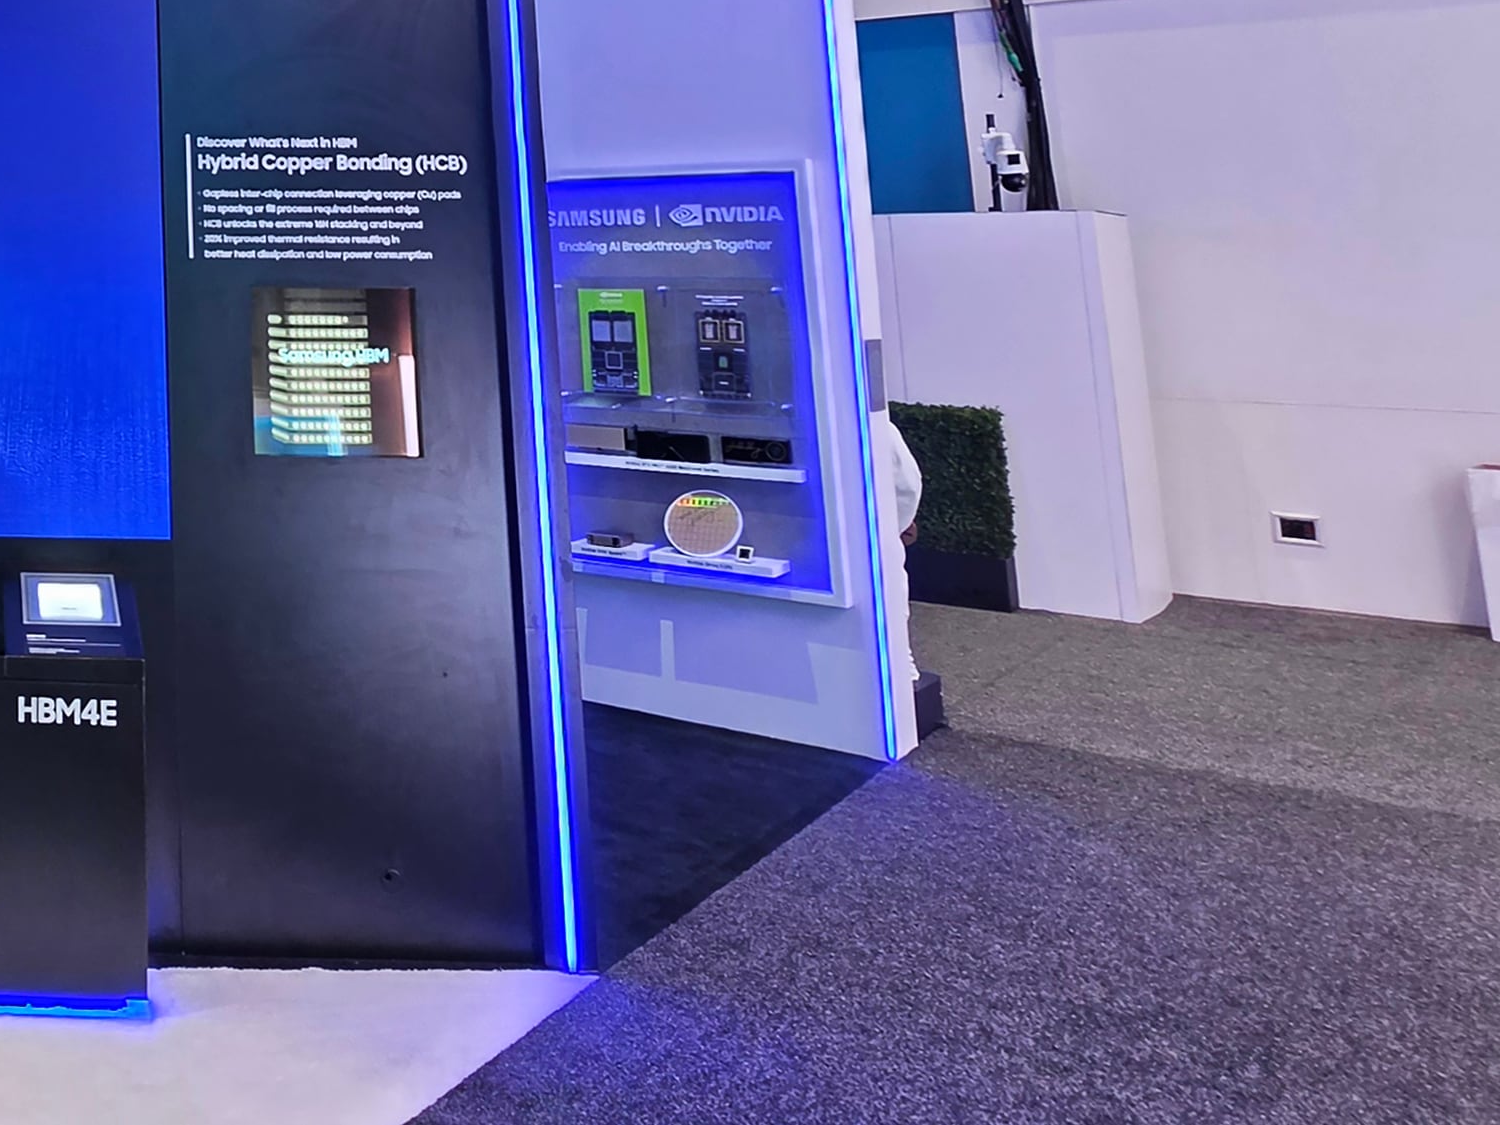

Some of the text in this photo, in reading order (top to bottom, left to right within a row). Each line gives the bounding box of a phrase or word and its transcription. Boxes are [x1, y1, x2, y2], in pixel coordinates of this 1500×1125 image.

[196, 136, 358, 149] Discover What's Next in HBM
[197, 152, 468, 176] Hybrid Copper Bonding (HCB)
[548, 208, 646, 227] SAMSUNG
[558, 239, 773, 255] Enabling AI Breakthroughs Together
[357, 347, 390, 363] HBM
[17, 696, 118, 727] HBM4E
